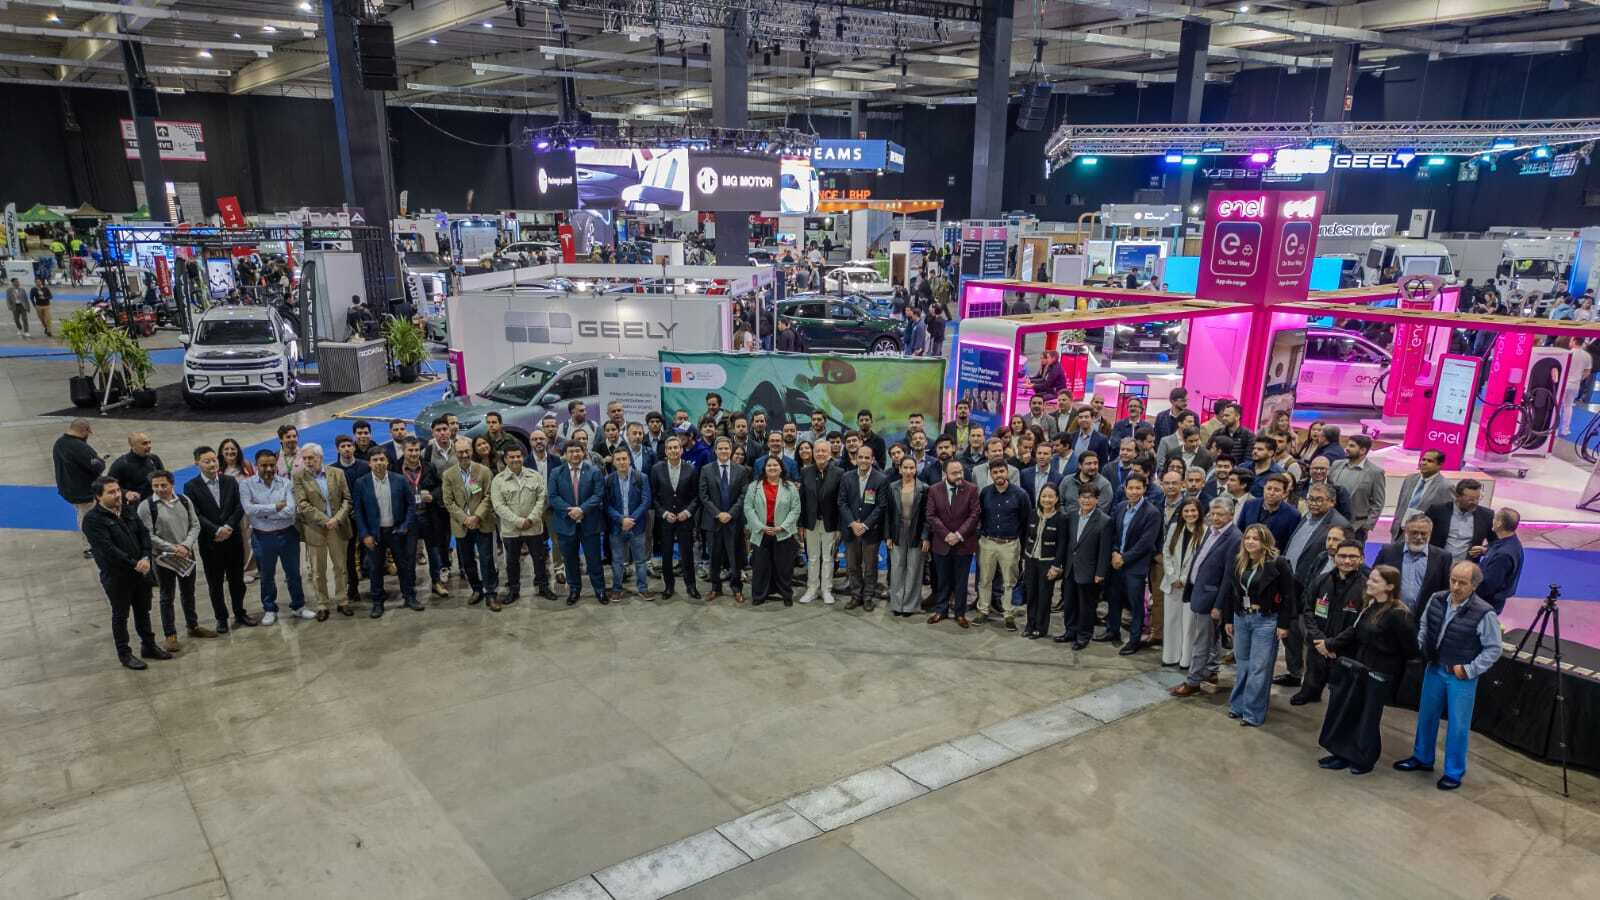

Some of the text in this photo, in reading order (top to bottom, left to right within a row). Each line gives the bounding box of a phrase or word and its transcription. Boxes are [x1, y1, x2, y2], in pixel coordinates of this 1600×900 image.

[1333, 154, 1415, 168] GEELY
[722, 175, 773, 188] MG MOTOR
[819, 189, 839, 200] NCE
[1217, 195, 1266, 218] enel
[1319, 222, 1391, 237] ndesmotor
[578, 320, 679, 339] GEELY
[1355, 375, 1380, 384] ene
[1428, 430, 1460, 445] enel
